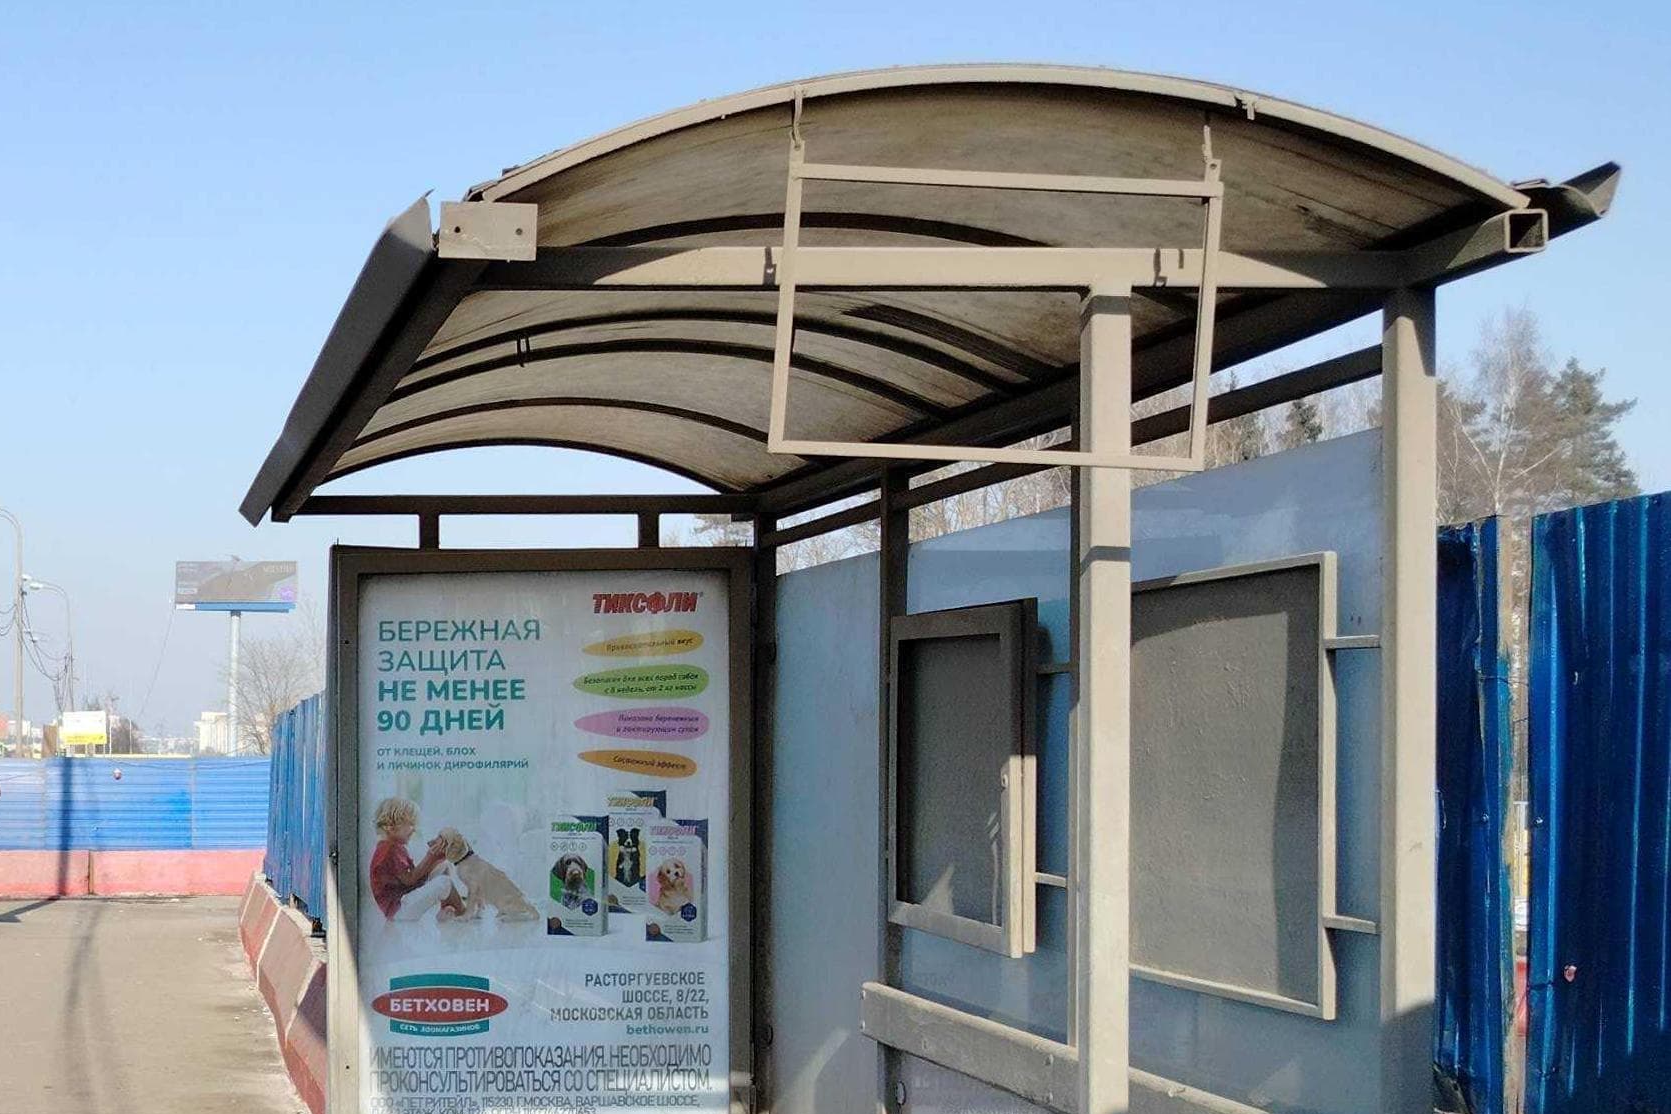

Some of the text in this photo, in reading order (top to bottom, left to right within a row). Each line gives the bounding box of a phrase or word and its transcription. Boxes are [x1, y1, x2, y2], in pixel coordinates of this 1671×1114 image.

[379, 619, 540, 642] БЕРЕЖНАЯ
[378, 649, 506, 676] ЗАЩИТА
[379, 679, 526, 701] НЕ МЕНЕЕ
[377, 702, 505, 736] 90 ДНЕЙ
[377, 745, 477, 758] ОТ КЛЕЩЕЙ, БЛОХ
[377, 758, 529, 771] И ЛИЧИНОК ДИРОФИЛЯРИЙ
[585, 972, 705, 987] РАСТОРГУЕВСКОЕ
[622, 988, 709, 1005] ШОССЕ, 8/22,
[390, 998, 489, 1012] БЕТХОВЕН
[550, 1006, 709, 1021] МОСКОВСКАЯ ОБЛАСТЬ
[626, 1023, 709, 1035] bethowen.ru
[370, 1043, 712, 1070] ИМЕЮТСЯ ПРОТИВОПОКАЗАНИЯ. НЕОБХОДИМО
[370, 1068, 713, 1094] ПРОКОНСУЛЬТИРОВАТЬСЯ СО СПЕЦИАЛИСТОМ.
[575, 1095, 655, 1107] ВАРШАВСКОЕ
